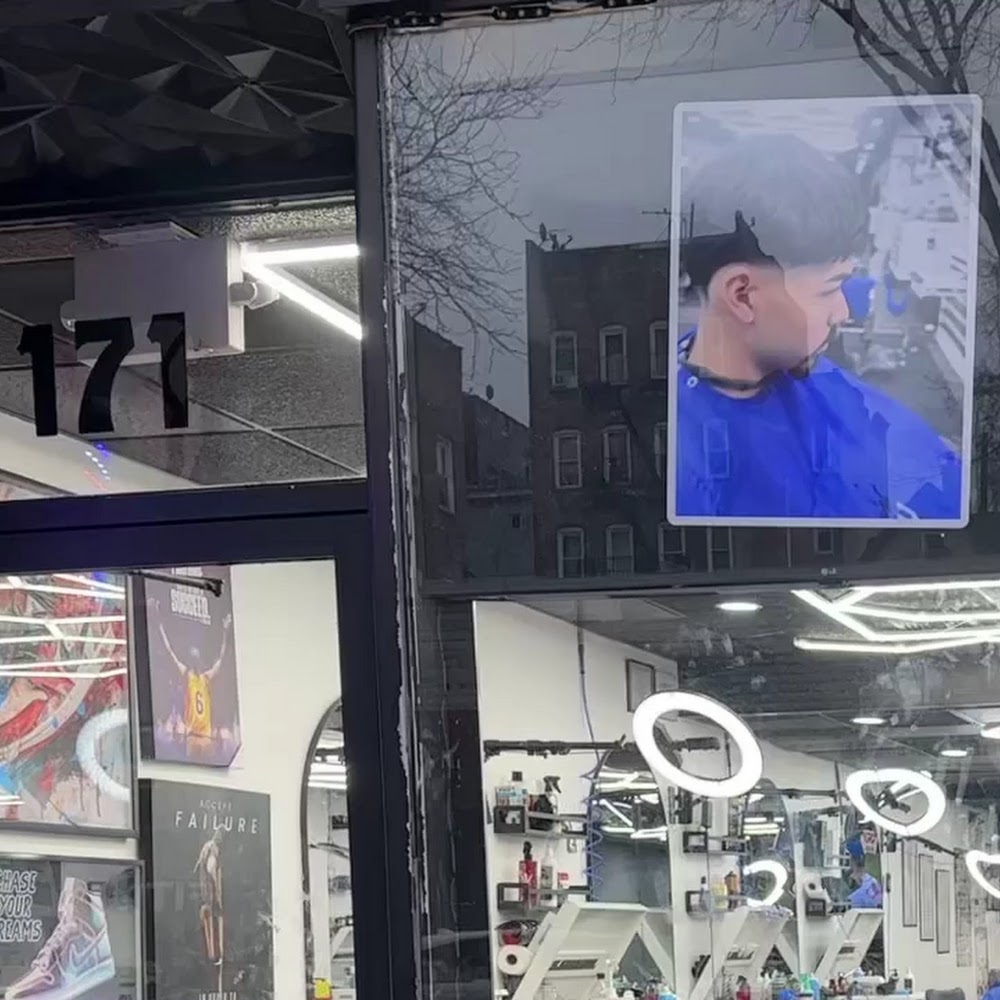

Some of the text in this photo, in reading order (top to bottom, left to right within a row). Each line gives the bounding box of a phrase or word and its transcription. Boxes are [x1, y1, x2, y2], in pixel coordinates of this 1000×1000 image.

[17, 311, 190, 437] 171
[195, 690, 204, 715] 6
[175, 810, 260, 834] FAILURE
[0, 894, 33, 918] YOUR
